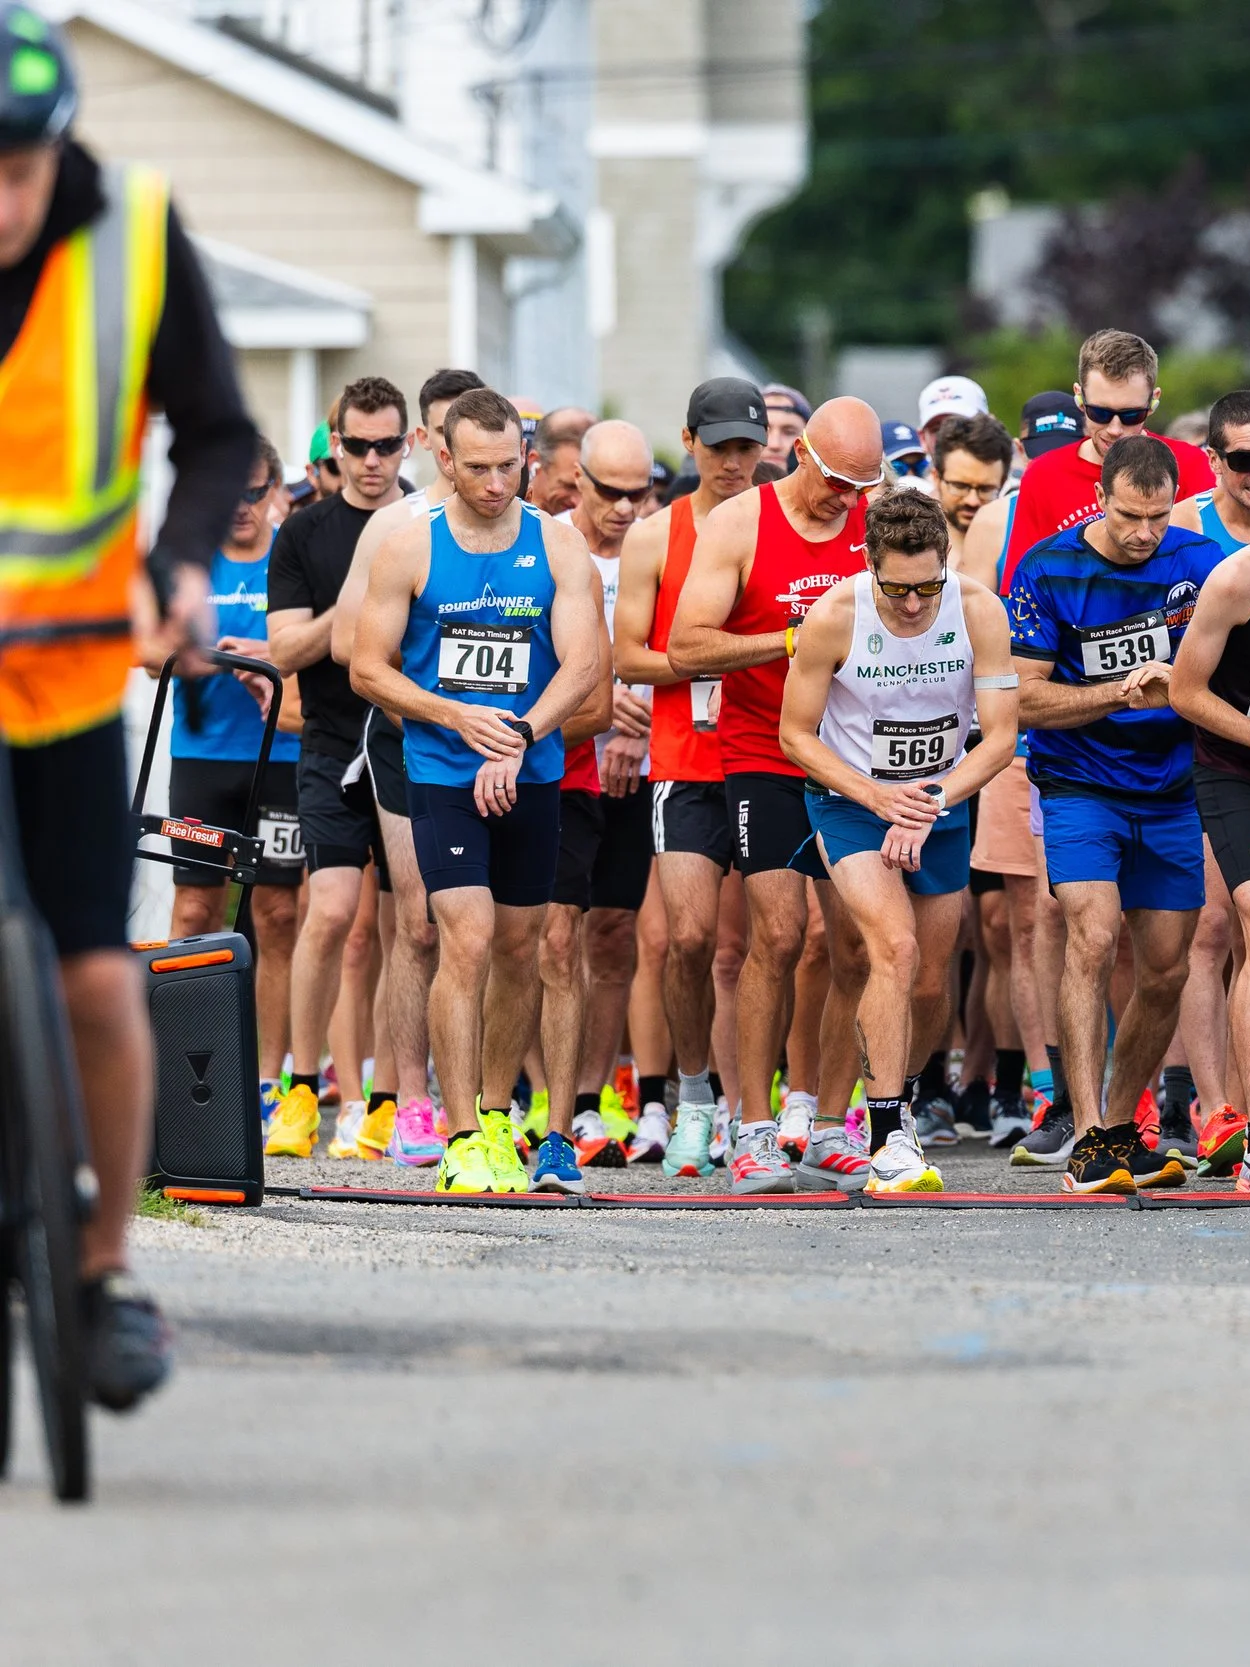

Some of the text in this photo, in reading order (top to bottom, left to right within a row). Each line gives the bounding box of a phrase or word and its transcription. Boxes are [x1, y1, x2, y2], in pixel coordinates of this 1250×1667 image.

[438, 595, 534, 614] soundRUNNER
[504, 607, 543, 617] RACING
[452, 628, 511, 640] RAT Race Timing
[1090, 622, 1146, 639] RAT Race Timing
[455, 643, 515, 678] 704
[1098, 634, 1156, 671] 539
[857, 659, 966, 679] MANCHESTER
[876, 676, 946, 688] RUNNING CLUB
[899, 725, 917, 733] Race
[918, 724, 940, 733] Timing
[888, 736, 945, 767] 569
[191, 831, 220, 844] result
[738, 800, 750, 858] USATF
